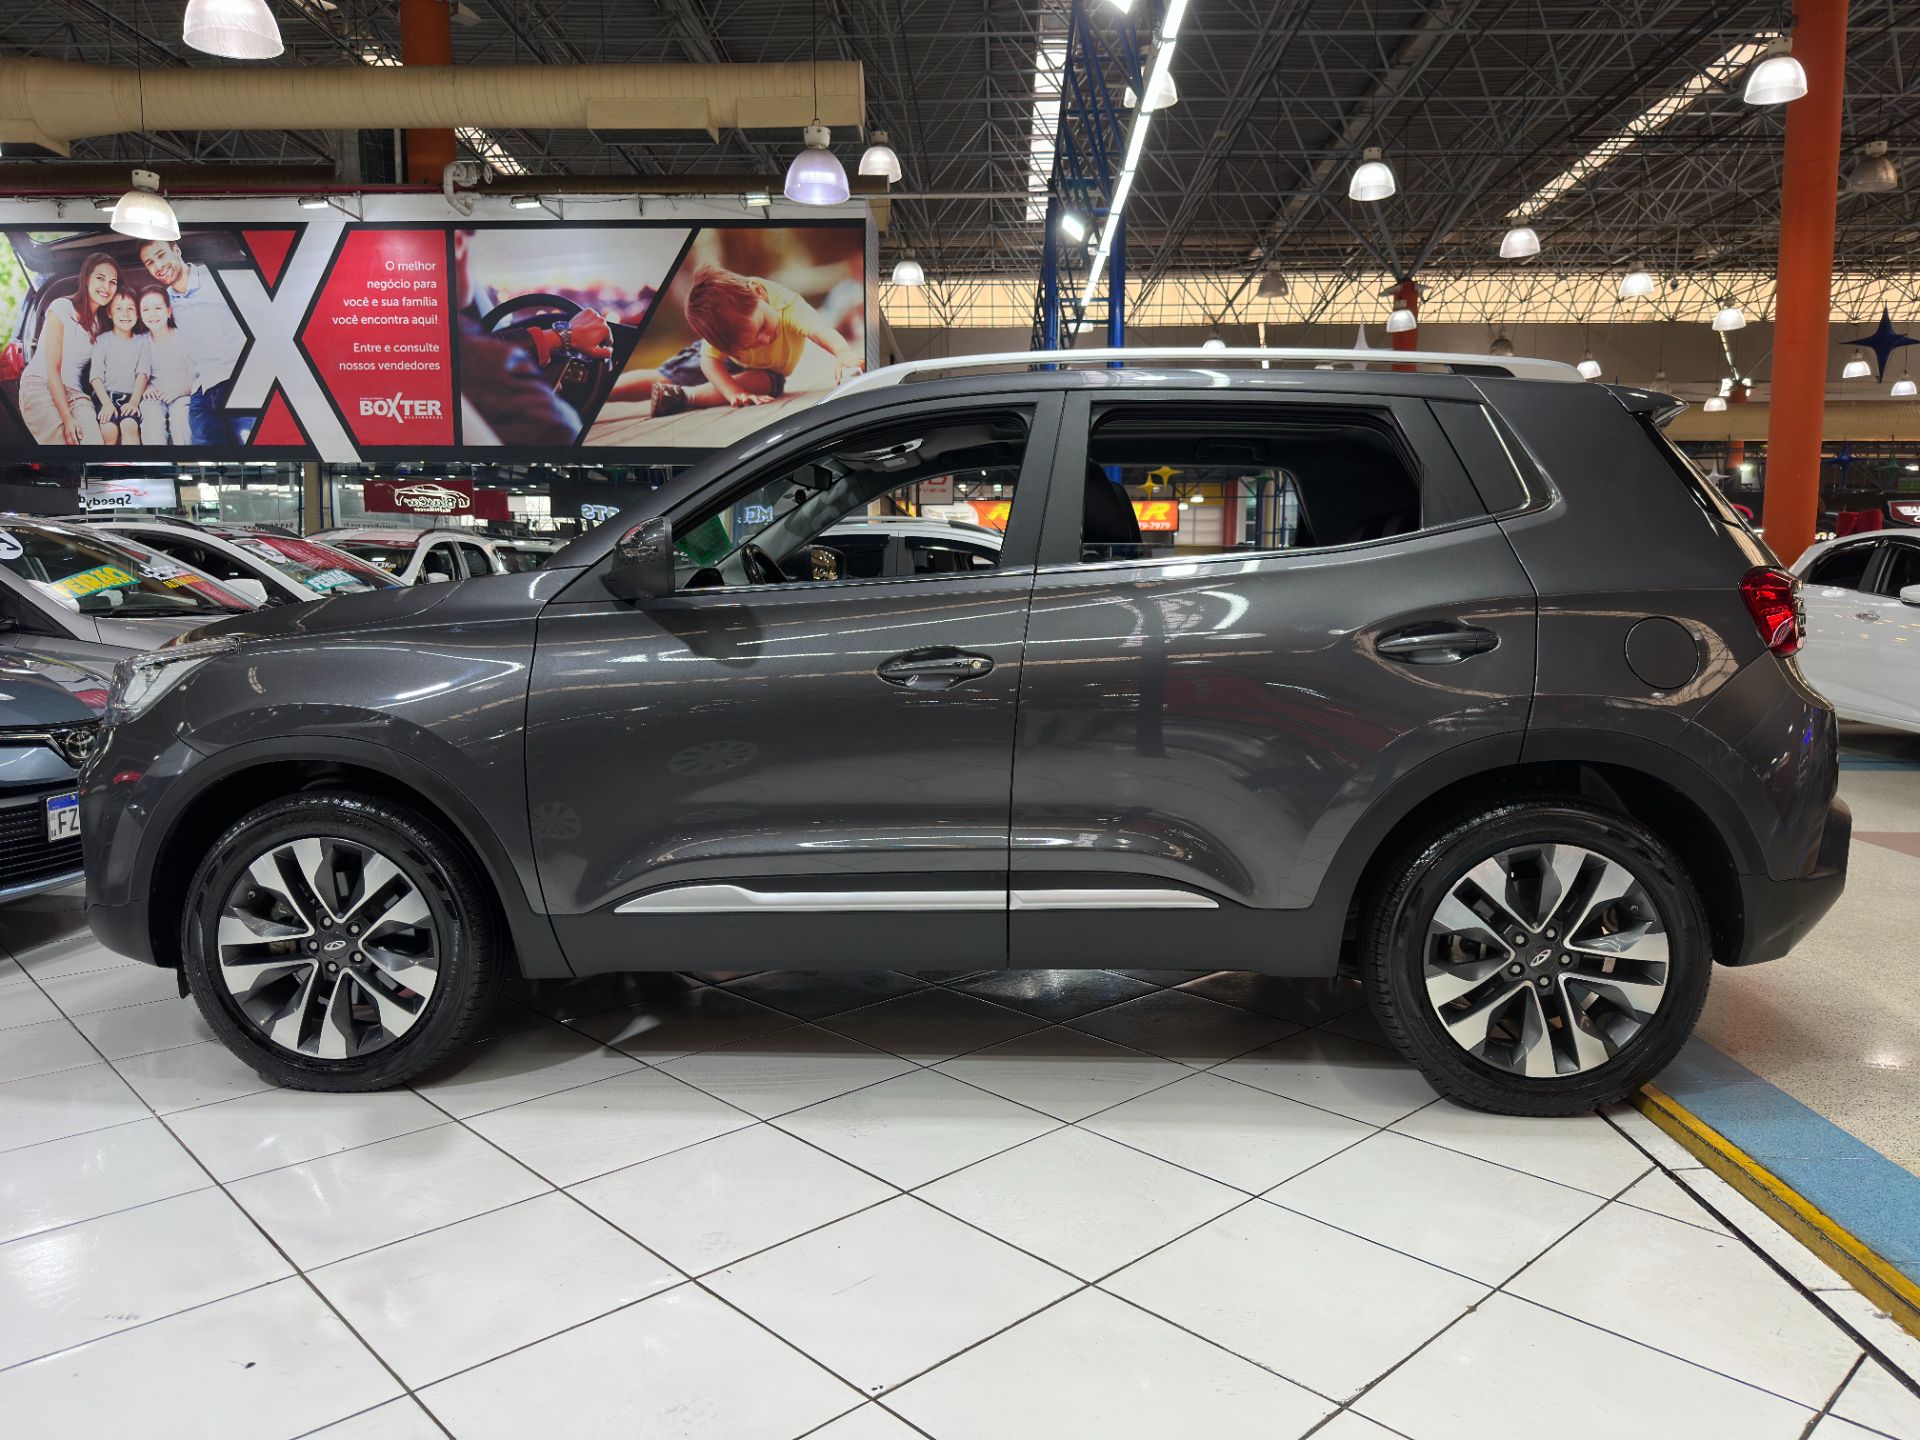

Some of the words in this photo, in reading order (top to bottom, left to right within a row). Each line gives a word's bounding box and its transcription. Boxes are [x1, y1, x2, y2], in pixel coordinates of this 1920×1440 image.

[385, 261, 395, 271] O
[398, 261, 436, 271] melhor
[367, 279, 411, 291] negócio
[413, 280, 437, 291] para
[343, 297, 369, 307] você
[371, 299, 379, 307] e
[381, 299, 399, 307] sua
[402, 297, 438, 307] família
[332, 315, 358, 325] você
[361, 316, 409, 325] encontra
[411, 315, 438, 326] aqui!
[353, 343, 381, 353] Entre
[384, 345, 391, 353] e
[394, 343, 440, 353] consulte
[339, 362, 375, 370] nossos
[378, 361, 441, 370] vendedores
[359, 392, 443, 424] BOXTER
